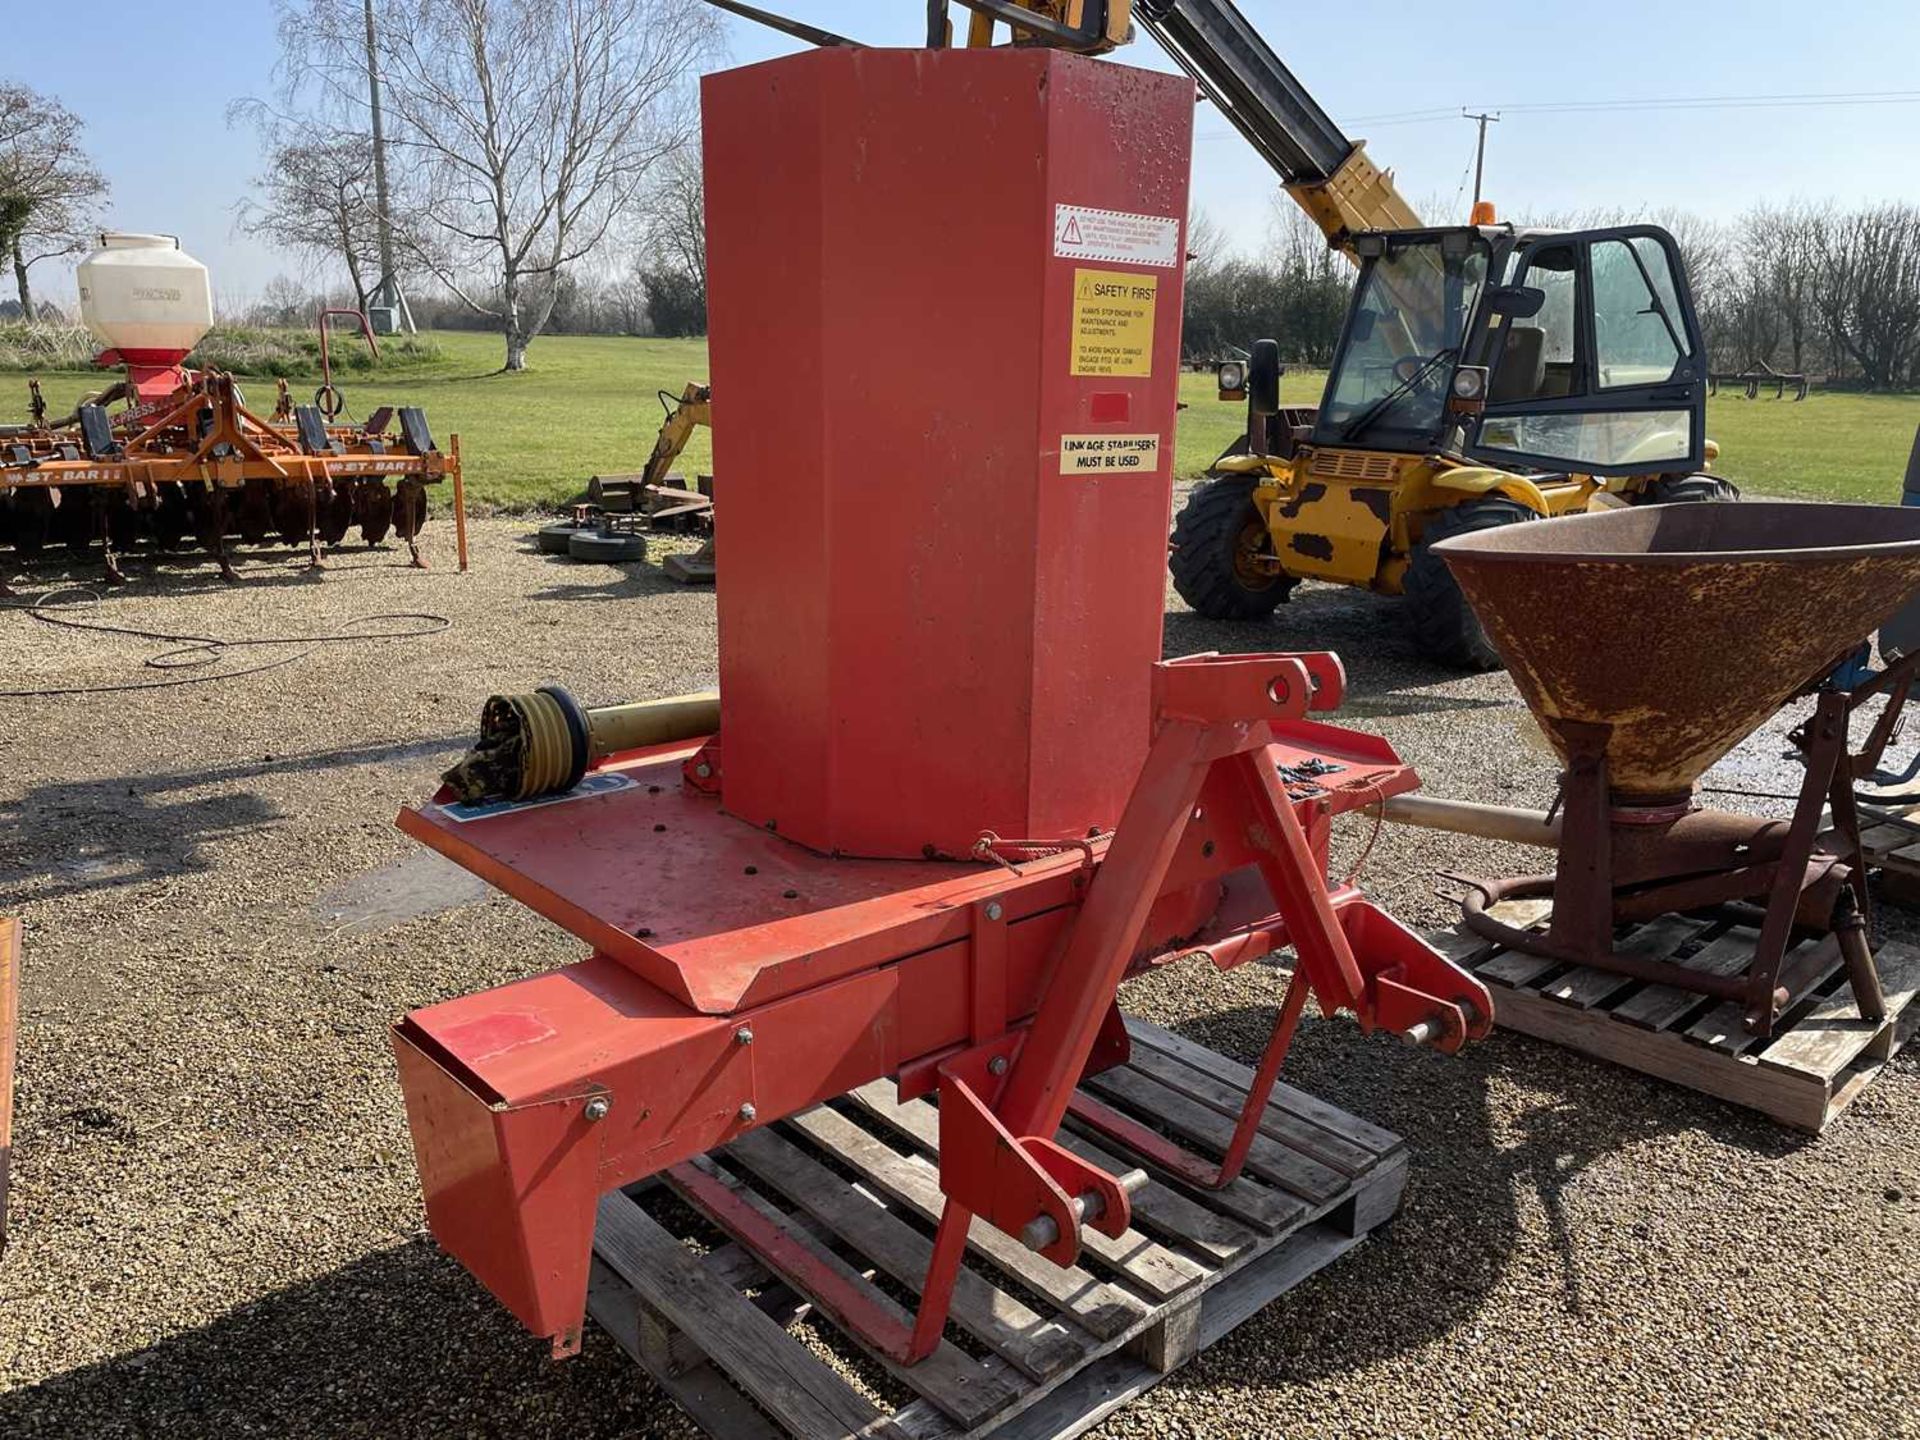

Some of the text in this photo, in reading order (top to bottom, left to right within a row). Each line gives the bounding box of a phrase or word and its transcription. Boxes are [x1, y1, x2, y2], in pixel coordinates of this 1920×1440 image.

[1095, 283, 1156, 300] SAFETY FIRST
[1081, 306, 1099, 314] ALWAYS
[1114, 309, 1131, 317] ENGINE
[1081, 316, 1128, 327] MAINTENANCE AND
[1088, 345, 1101, 353] AVOID
[1103, 346, 1120, 354] SHOCK
[1121, 346, 1142, 355] DAMAGE
[1079, 355, 1098, 363] ENGAGE
[1078, 364, 1096, 372] ENGINE
[1064, 441, 1104, 451] LINKAGE
[1077, 456, 1139, 467] MUST BE USED
